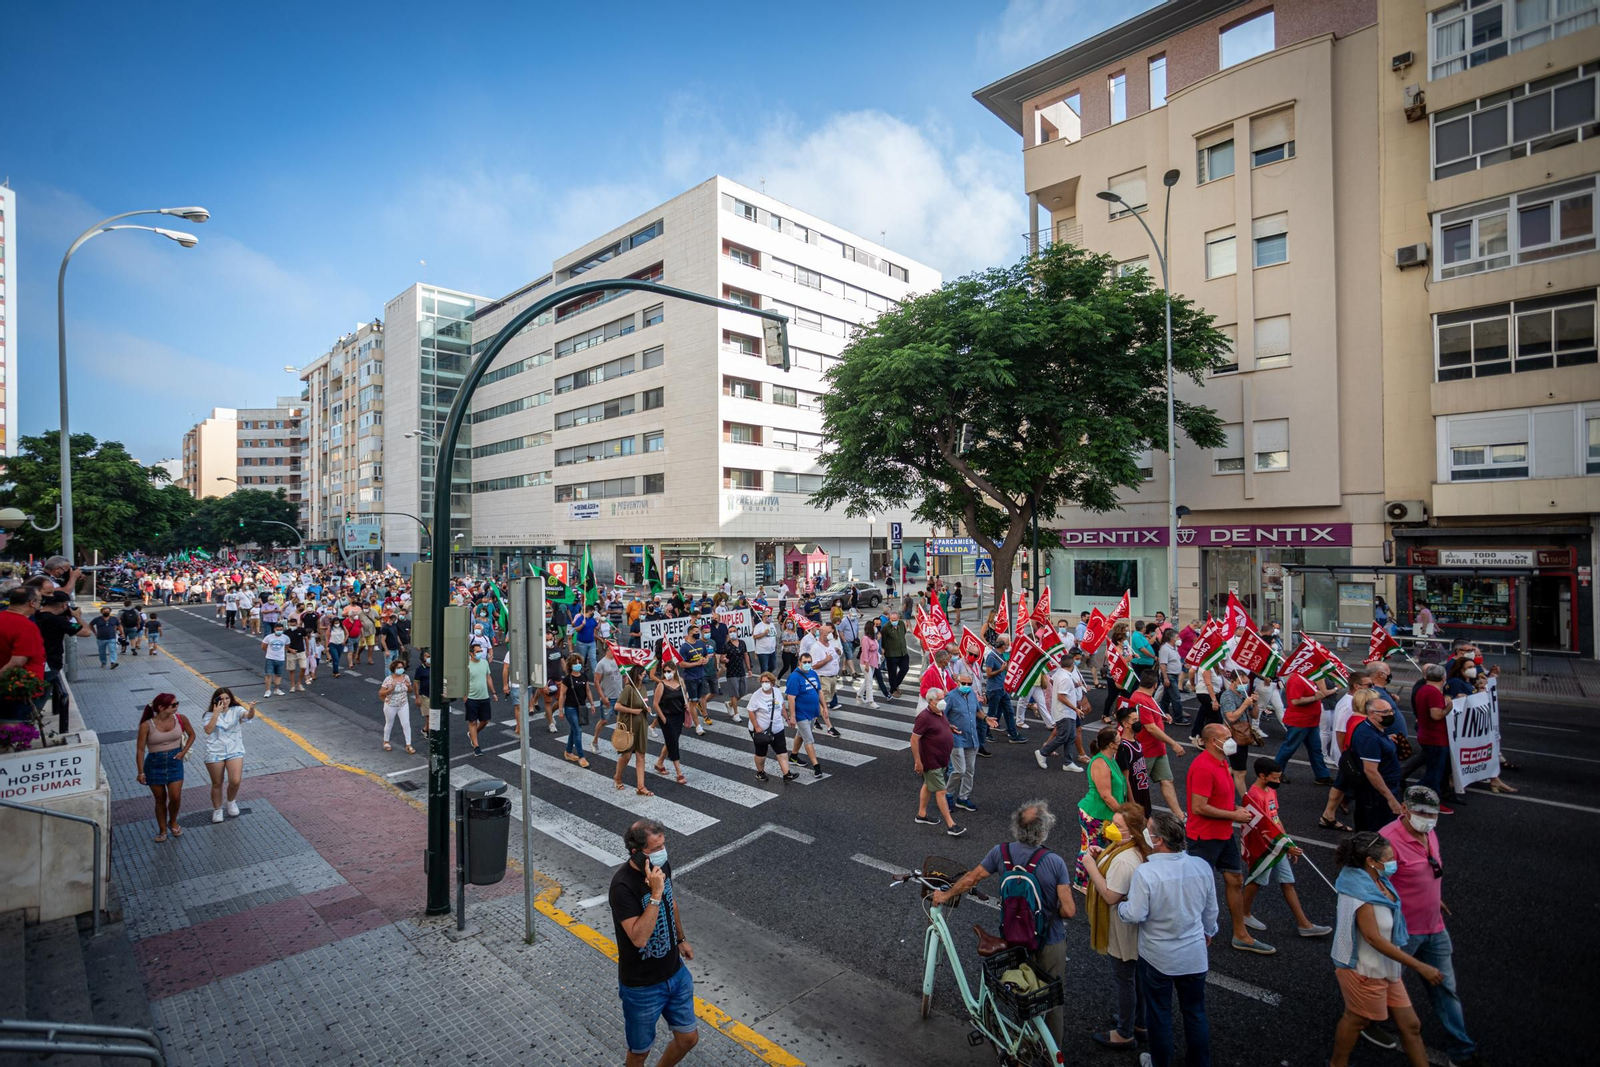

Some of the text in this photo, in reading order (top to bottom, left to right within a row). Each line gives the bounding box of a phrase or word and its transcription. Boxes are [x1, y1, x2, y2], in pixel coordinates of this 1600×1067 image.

[617, 500, 649, 510] PREVENTIVA
[736, 494, 780, 506] PREVENTIVA
[1066, 530, 1160, 543] DENTIX
[1210, 527, 1335, 542] DENTIX
[651, 623, 662, 637] EN
[719, 612, 744, 626] MPLEO
[736, 625, 752, 638] CIAL
[643, 635, 684, 652] EN SEC
[1461, 748, 1488, 762] CCOO
[22, 756, 82, 773] USTED
[8, 768, 82, 786] HOSPITAL
[1136, 771, 1149, 790] 2
[31, 778, 82, 794] FUMAR
